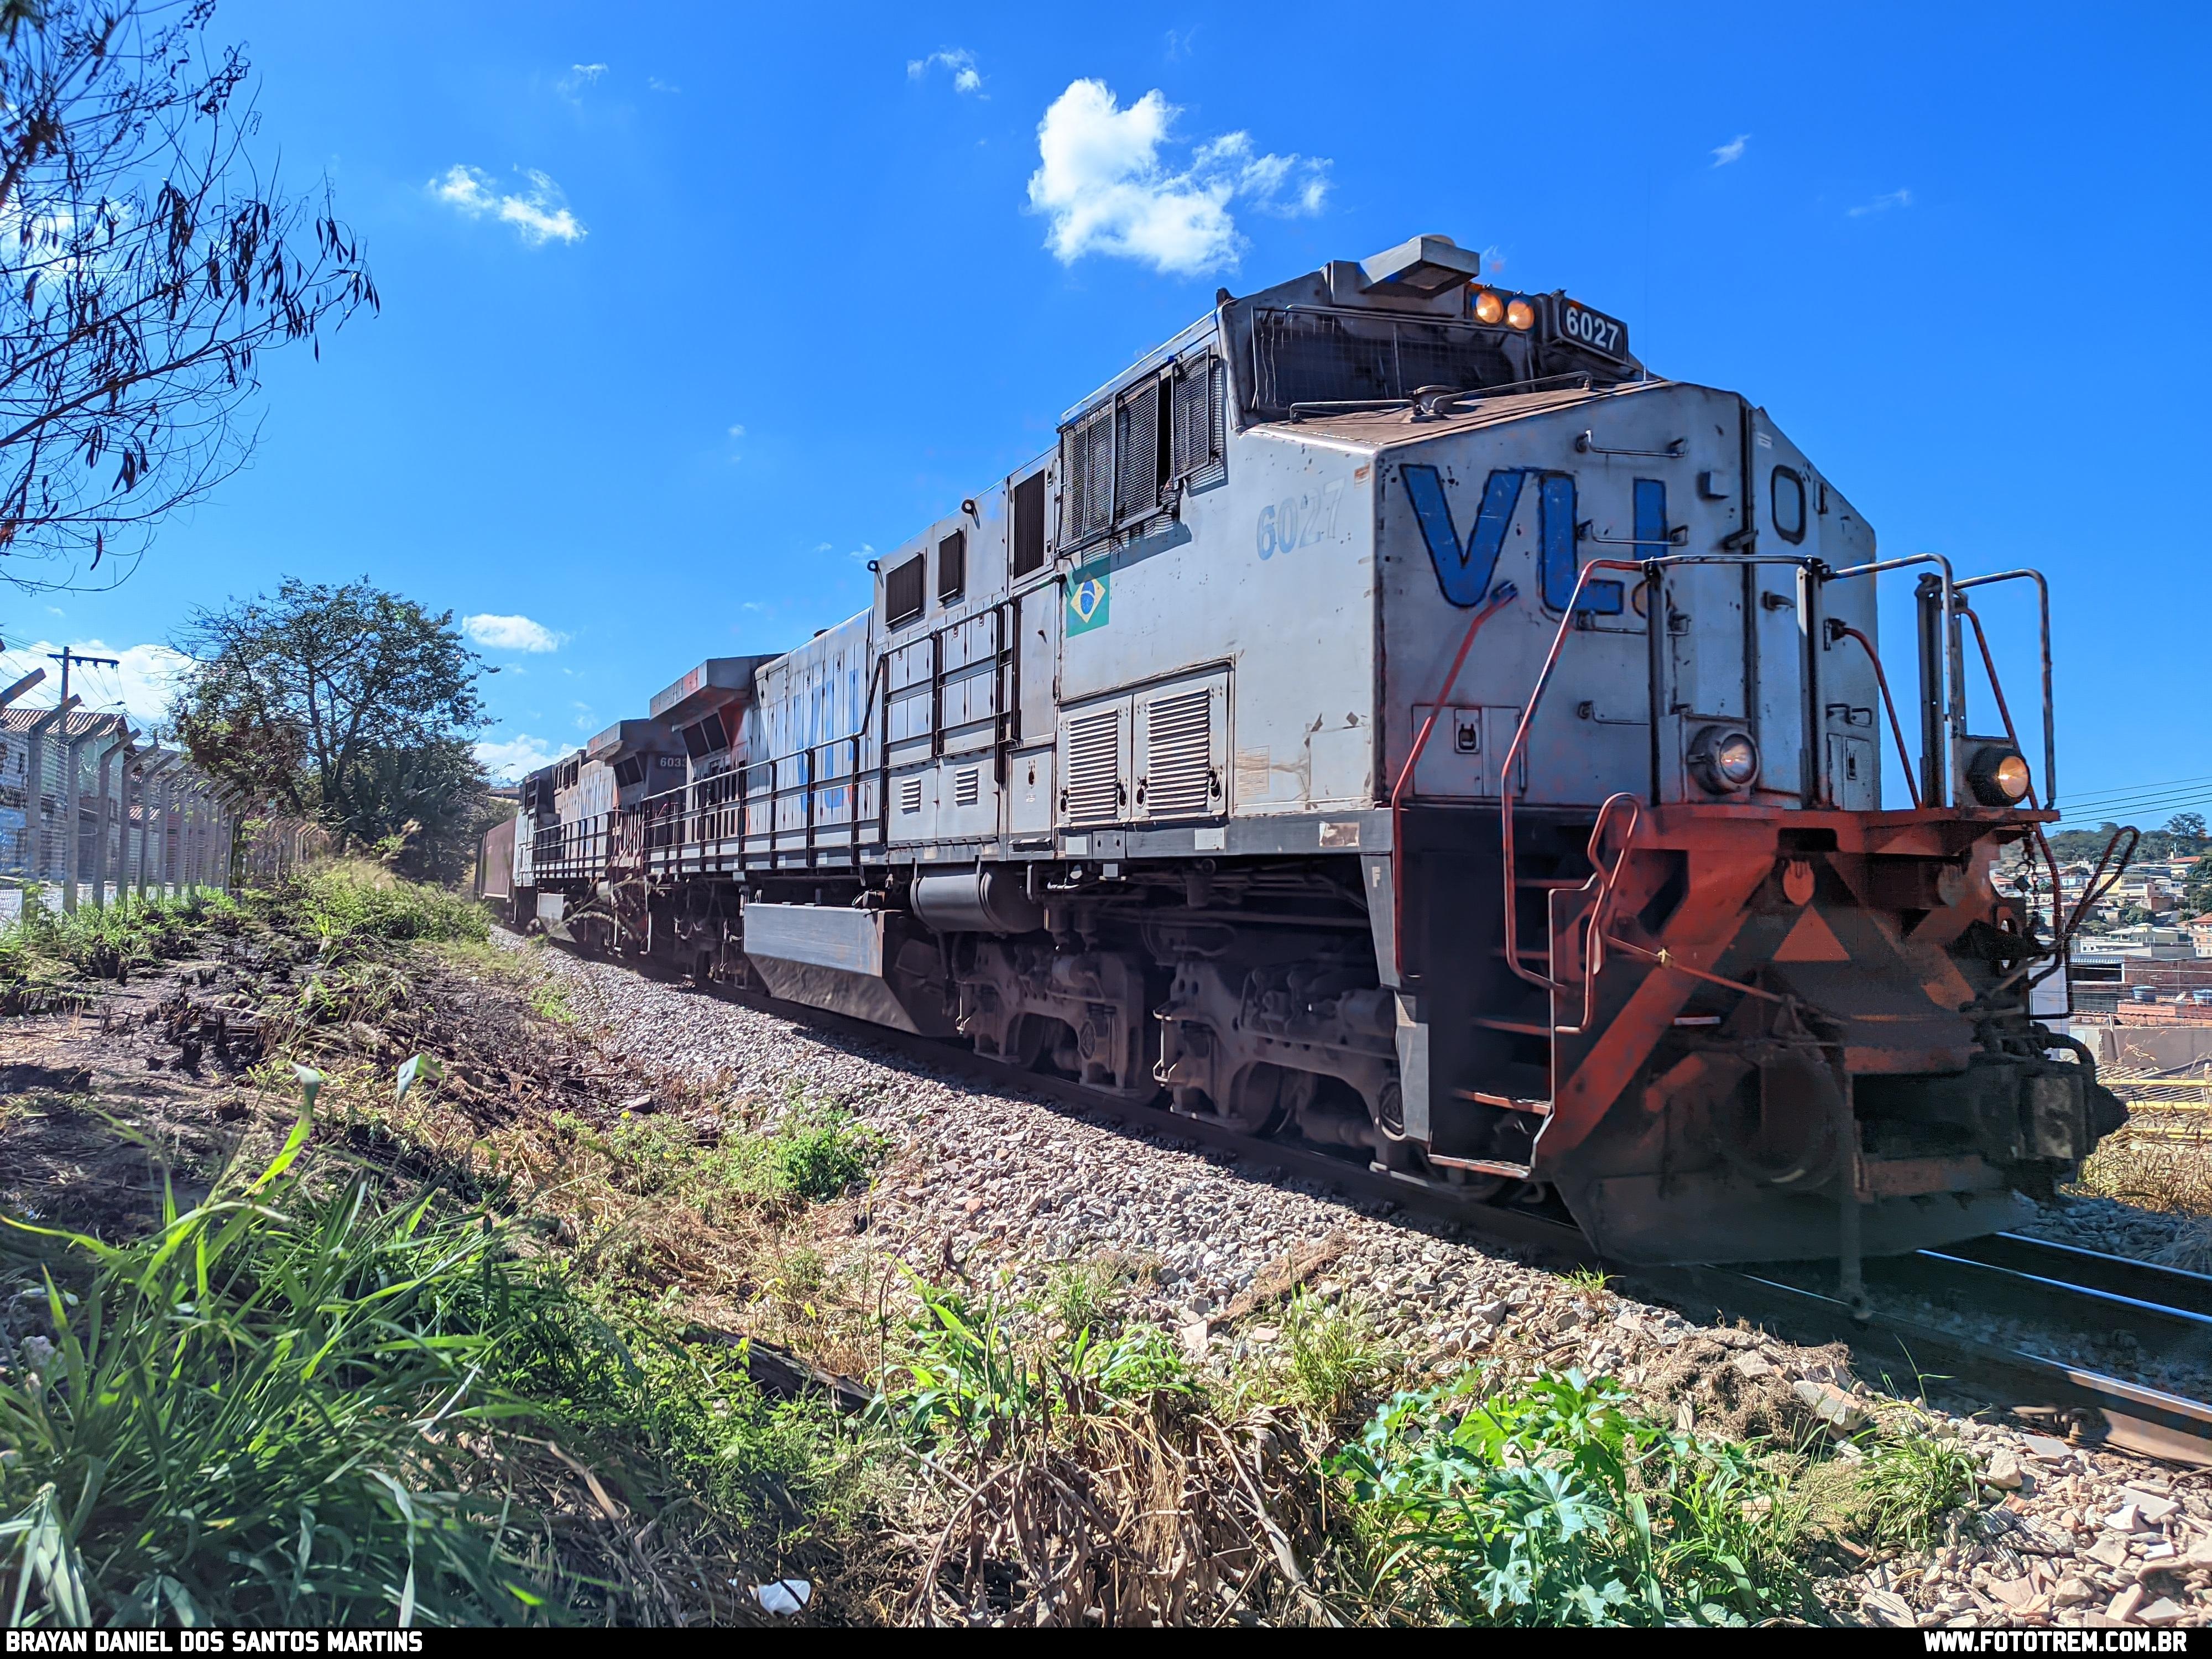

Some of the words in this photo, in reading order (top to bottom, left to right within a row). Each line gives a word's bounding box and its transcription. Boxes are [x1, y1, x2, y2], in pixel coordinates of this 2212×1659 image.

[1566, 306, 1619, 351] 6027
[1256, 478, 1345, 561] 6027
[1371, 867, 1381, 888] F
